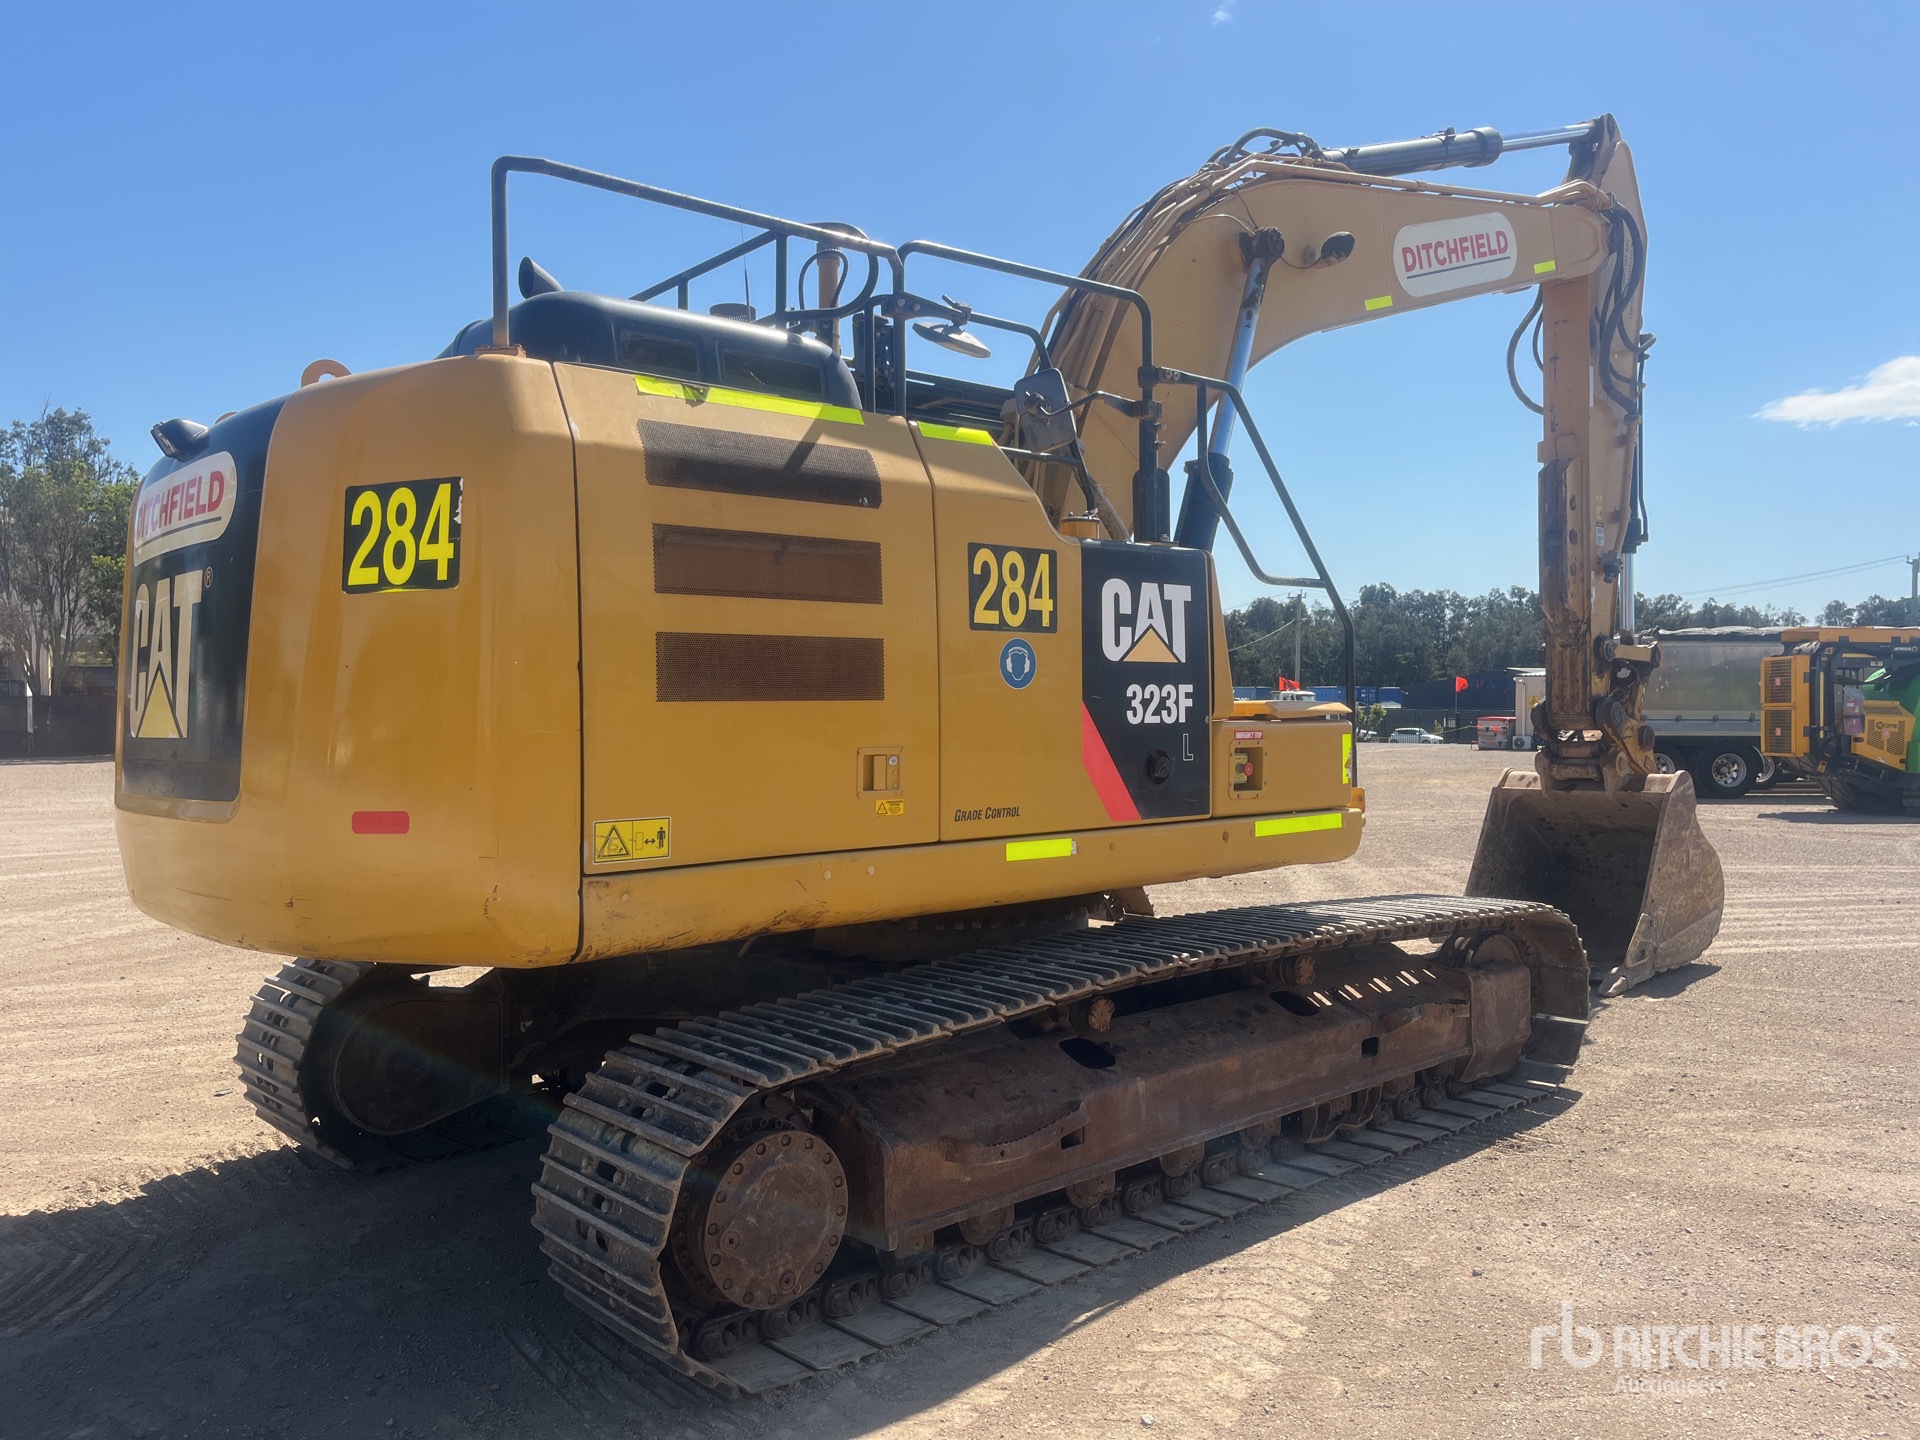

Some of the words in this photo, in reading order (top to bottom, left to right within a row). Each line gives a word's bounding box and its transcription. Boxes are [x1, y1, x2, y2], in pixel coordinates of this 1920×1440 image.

[1402, 230, 1509, 272] DITCHFIELD
[347, 483, 455, 586] 284
[972, 547, 1054, 628] 284
[1101, 578, 1192, 663] CAT
[1126, 684, 1194, 725] 323F
[1182, 733, 1194, 761] L
[954, 809, 983, 822] GRADE
[985, 807, 1021, 819] CONTROL
